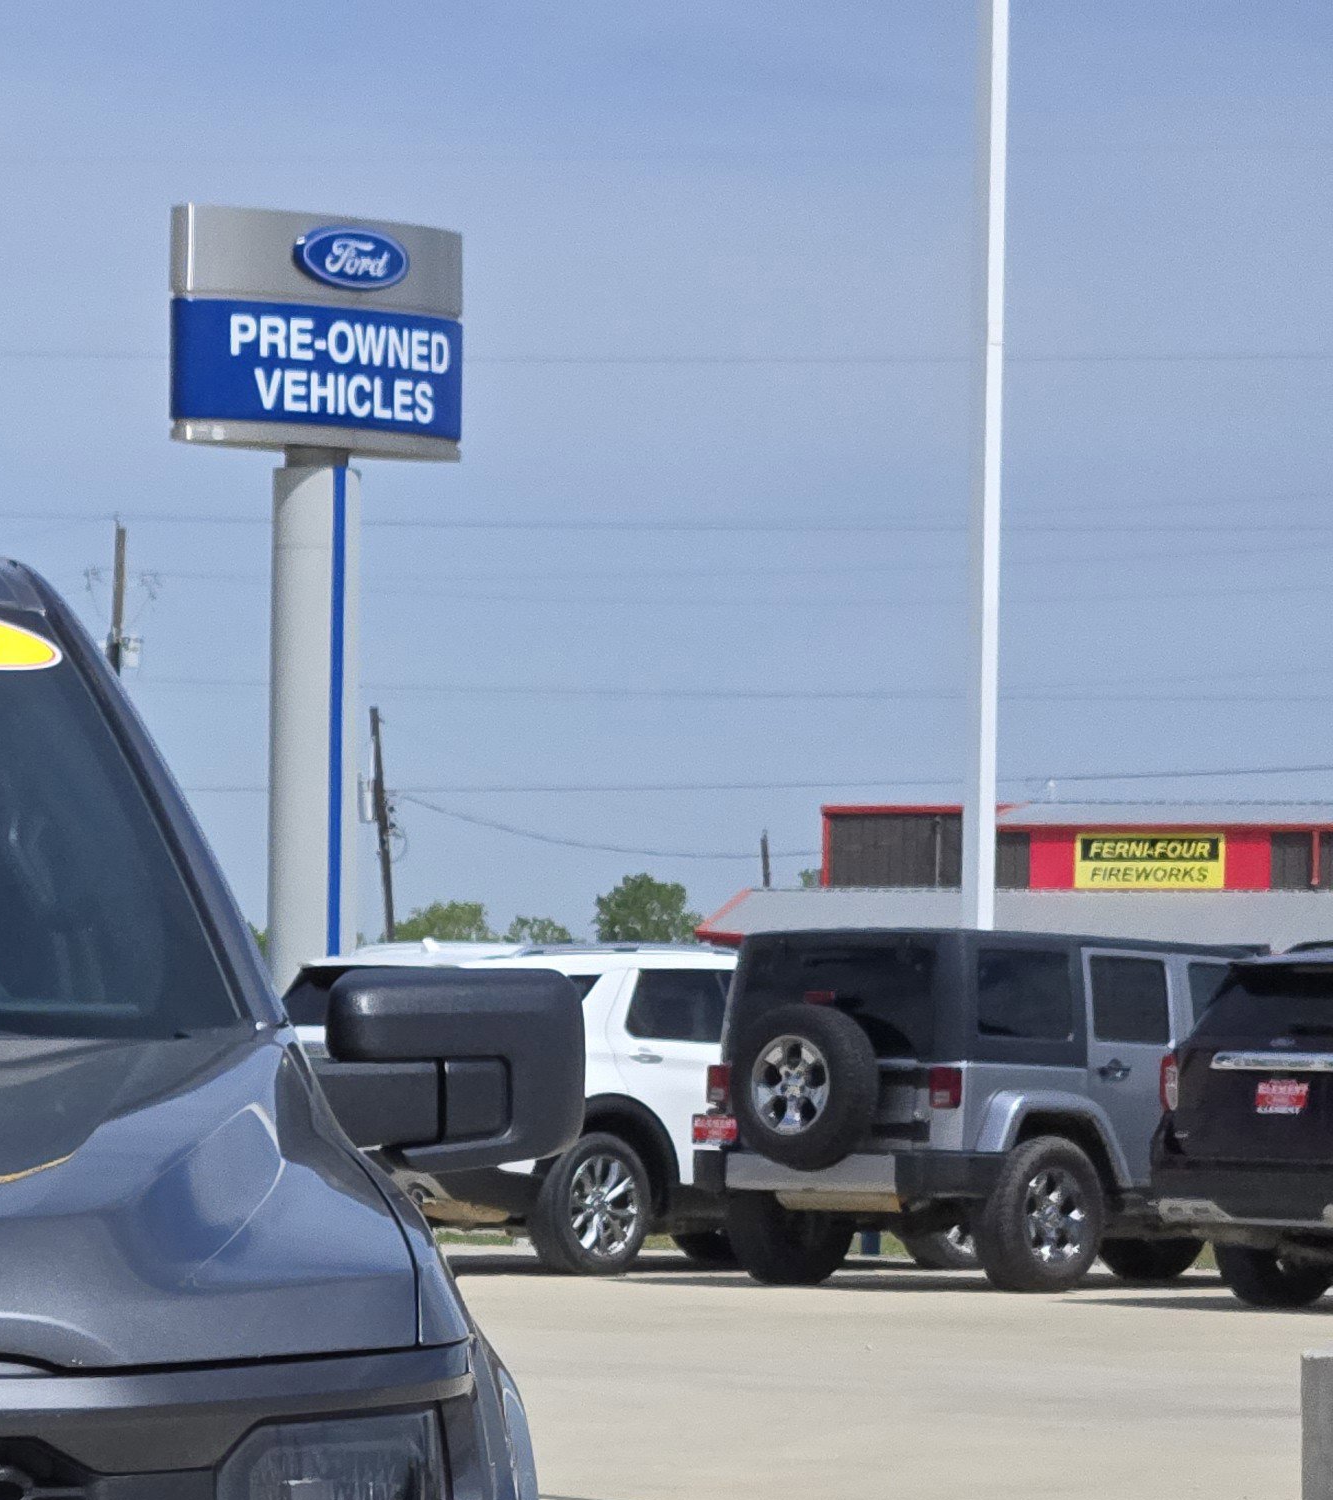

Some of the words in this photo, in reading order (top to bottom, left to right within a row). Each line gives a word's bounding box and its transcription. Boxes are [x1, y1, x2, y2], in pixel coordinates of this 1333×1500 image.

[325, 239, 390, 277] Ford
[230, 314, 451, 375] PRE-OWNED
[254, 368, 435, 424] VEHICLES
[1090, 866, 1209, 883] FIREWORKS
